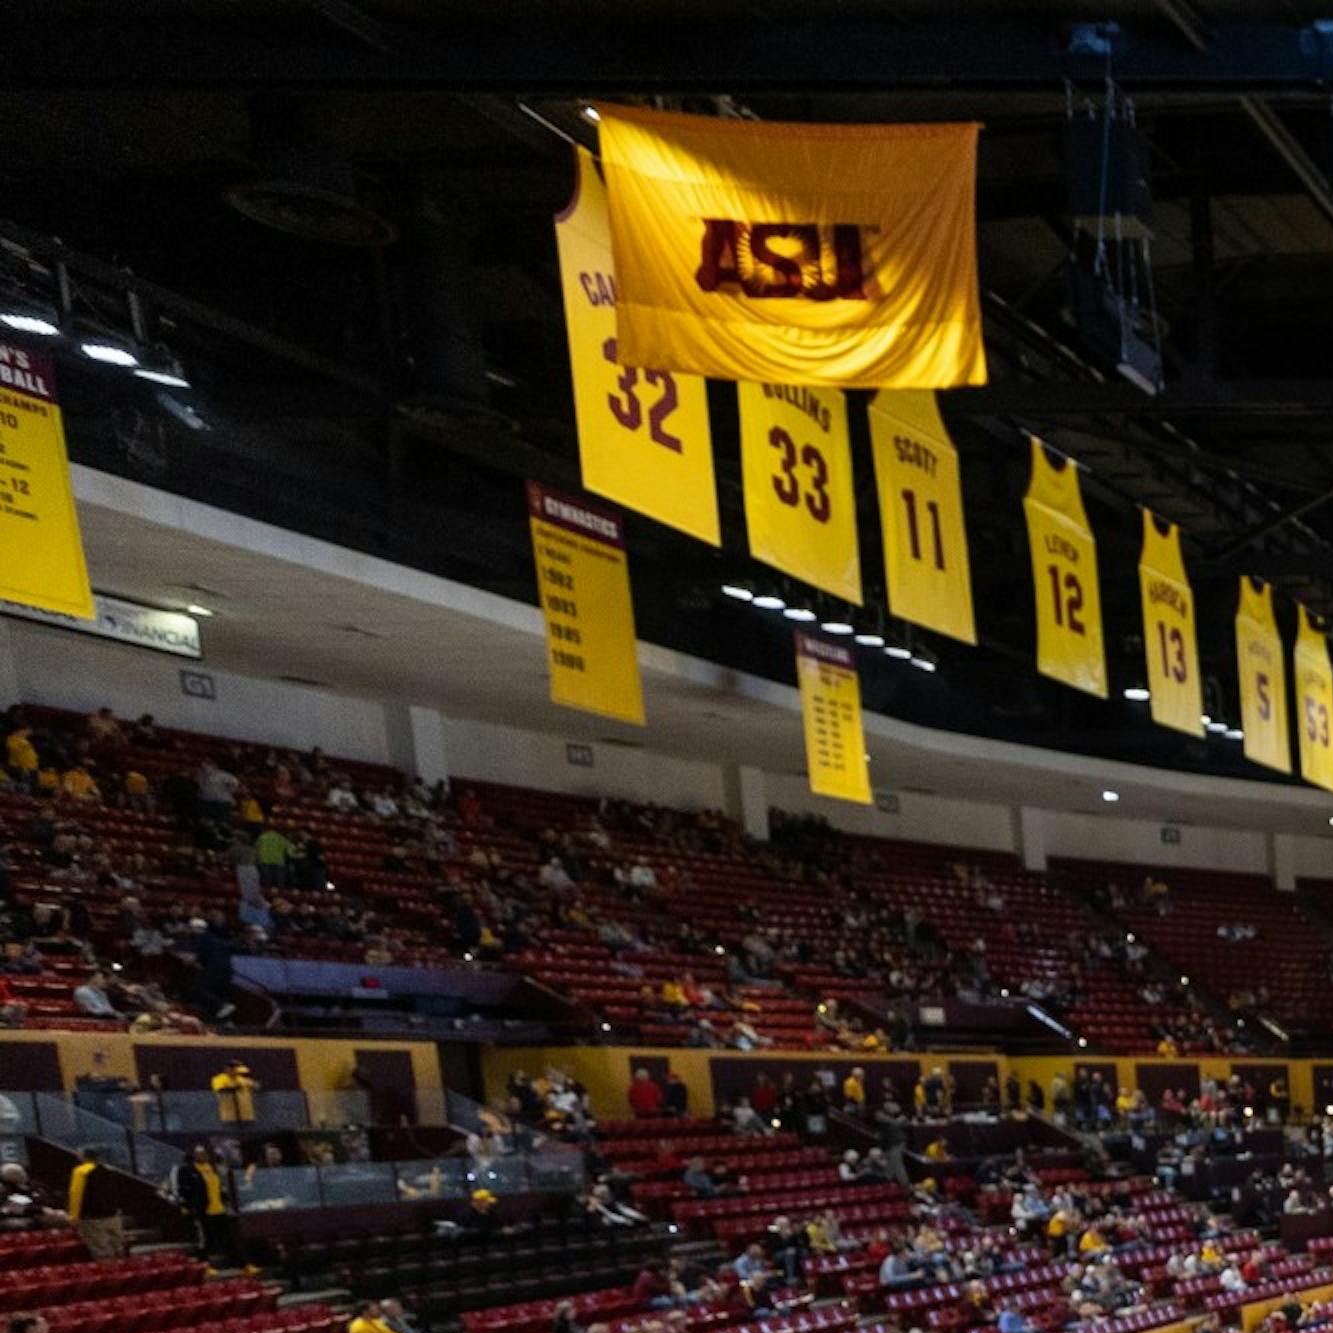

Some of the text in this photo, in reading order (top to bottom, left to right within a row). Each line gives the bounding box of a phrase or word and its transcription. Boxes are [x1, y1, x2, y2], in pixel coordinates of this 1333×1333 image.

[695, 217, 880, 302] ASU
[603, 338, 684, 455] 32
[768, 425, 831, 524] 33
[893, 434, 938, 479] SCOTT
[901, 488, 945, 570] 11
[1048, 564, 1086, 636] 12
[1157, 620, 1187, 684] 13
[1256, 671, 1271, 721] 5
